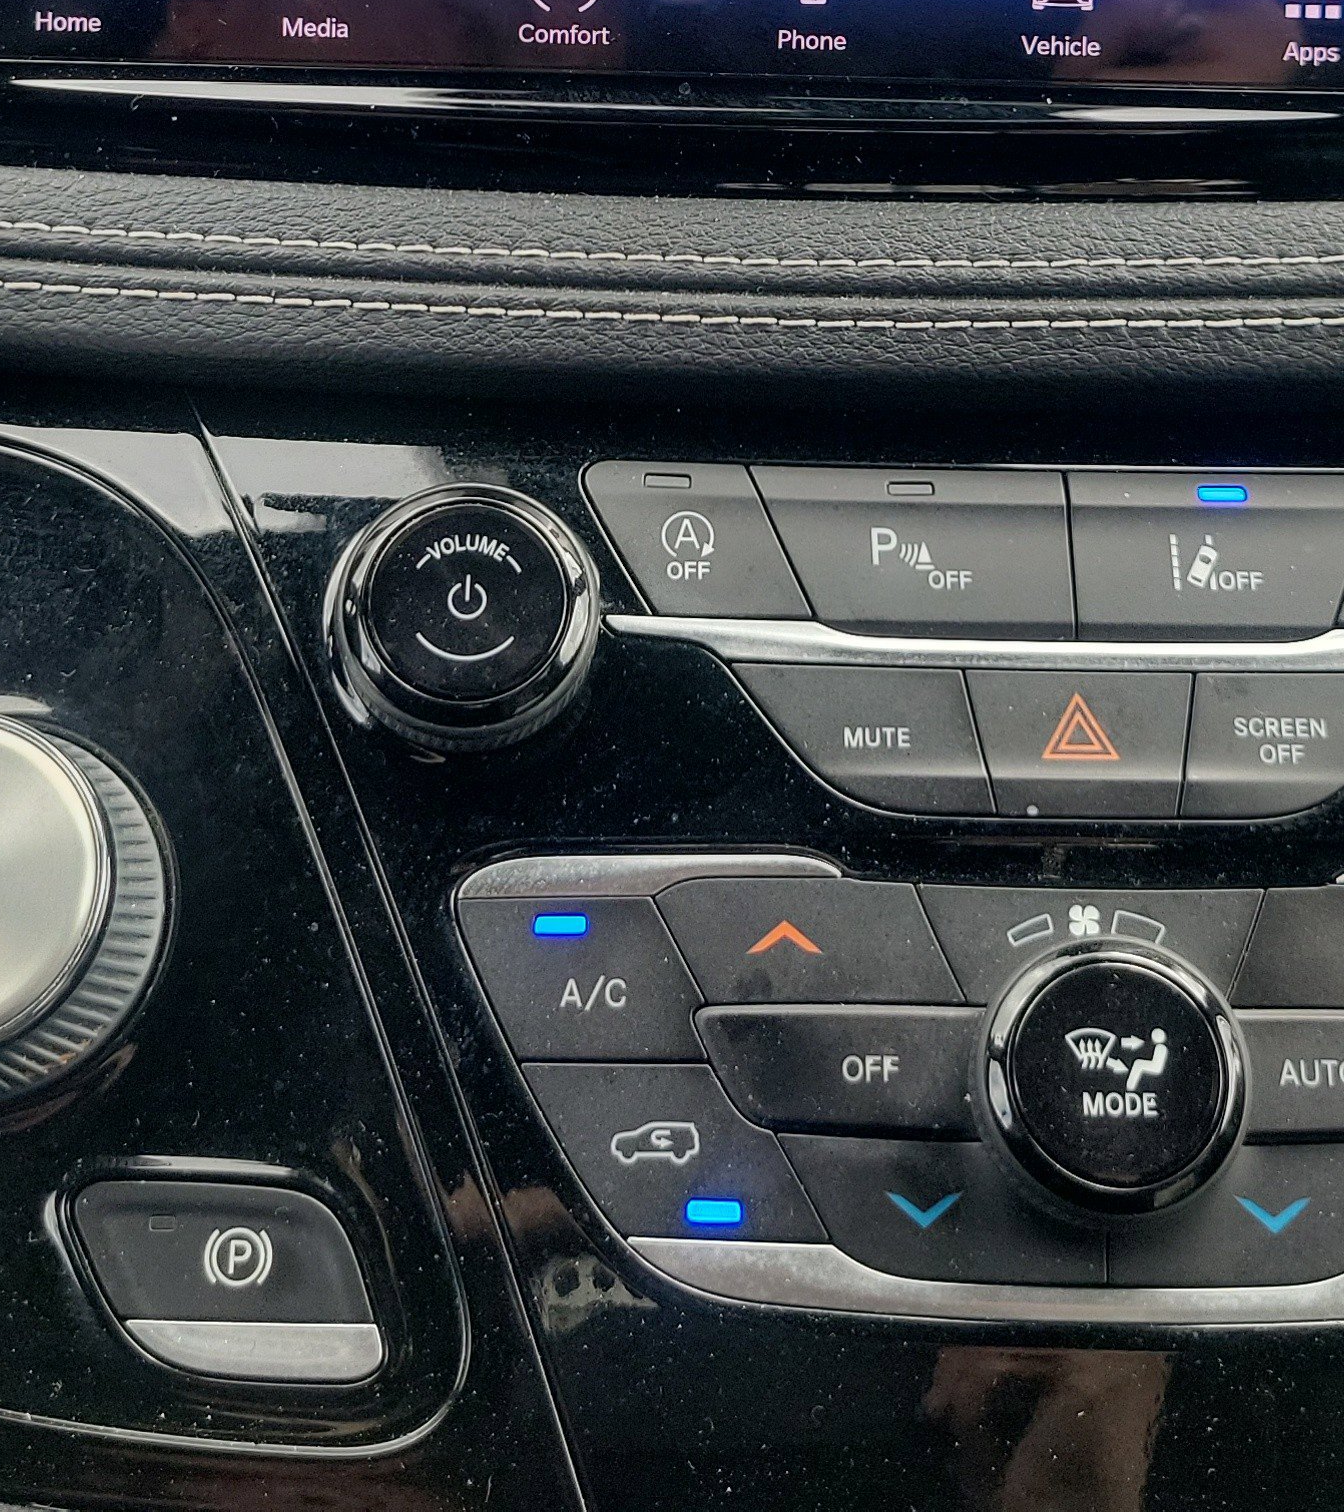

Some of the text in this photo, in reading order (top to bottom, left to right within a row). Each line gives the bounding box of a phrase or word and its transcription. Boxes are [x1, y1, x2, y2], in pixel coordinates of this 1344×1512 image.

[36, 12, 101, 32] Home
[283, 18, 348, 37] Media
[519, 24, 610, 44] Comfort
[778, 30, 846, 50] Phone
[1022, 36, 1101, 56] Vehicle
[1283, 42, 1340, 66] Apps
[675, 521, 696, 548] A
[425, 536, 511, 561] VOLUME
[872, 528, 897, 565] P
[667, 562, 710, 580] OFF
[928, 569, 973, 590] OFF
[1219, 571, 1263, 591] OFF
[844, 727, 910, 747] MUTE
[1234, 718, 1326, 737] SCREEN
[1260, 745, 1303, 763] OFF
[560, 976, 626, 1010] A/C
[843, 1056, 898, 1082] OFF
[1082, 1092, 1157, 1119] MODE
[227, 1238, 252, 1275] P
